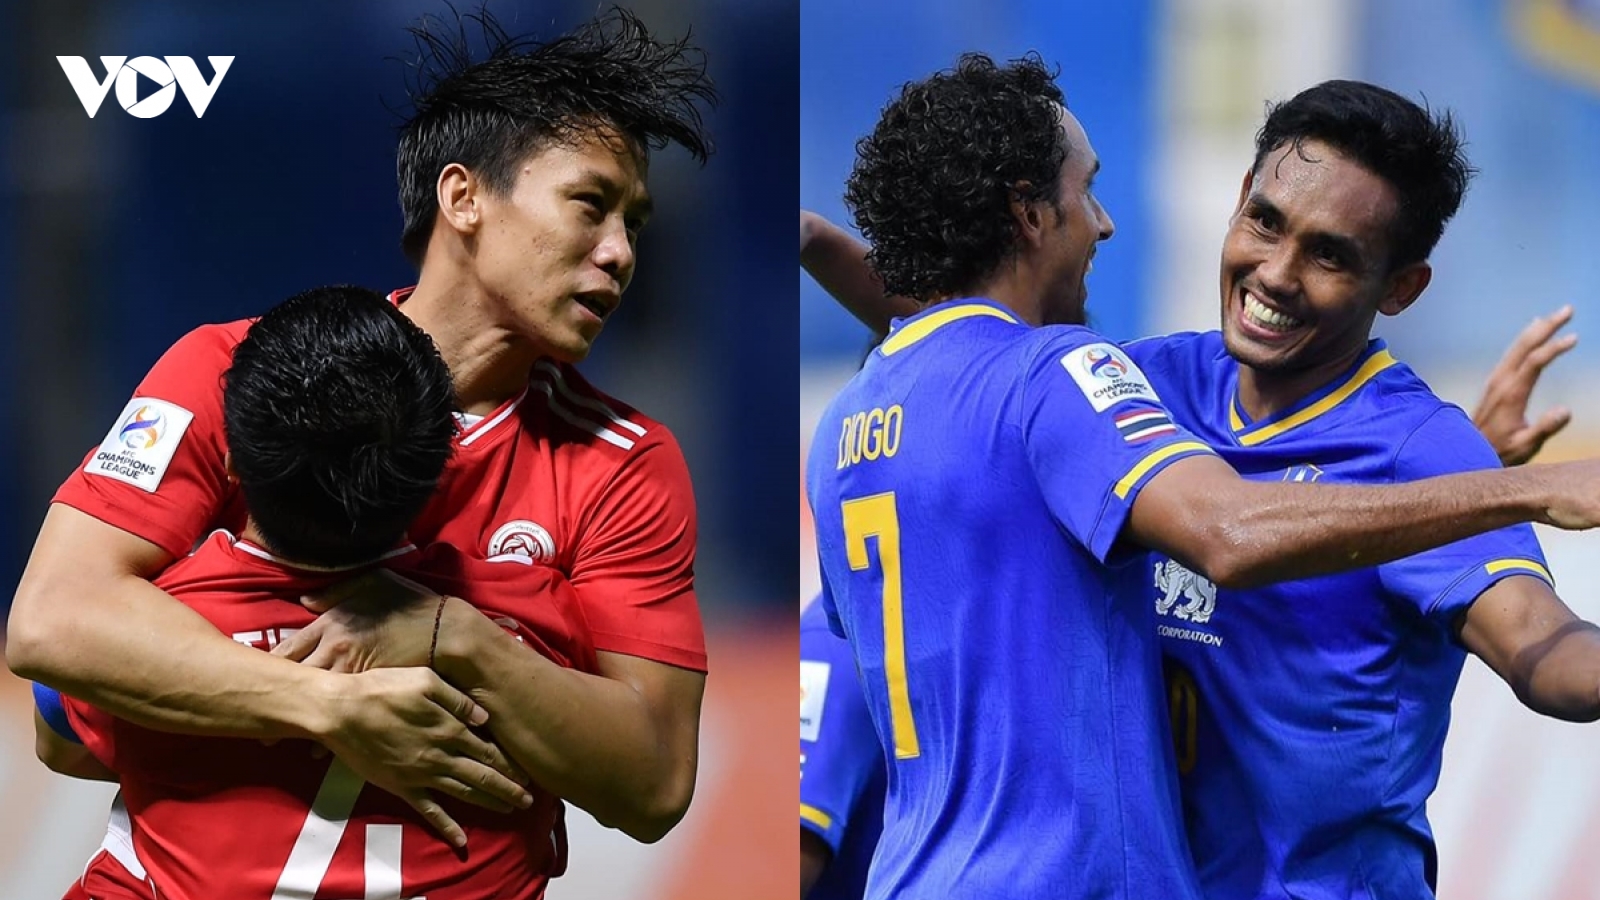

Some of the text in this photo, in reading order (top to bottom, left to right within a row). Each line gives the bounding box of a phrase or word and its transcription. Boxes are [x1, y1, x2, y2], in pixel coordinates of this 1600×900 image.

[836, 404, 903, 470] DIOGO
[97, 451, 157, 476] CHAMPIONS
[121, 450, 136, 458] AFC
[100, 460, 141, 480] LEAGUE
[841, 491, 920, 760] 7
[1157, 624, 1224, 648] CORPORATION
[270, 752, 427, 900] 4
